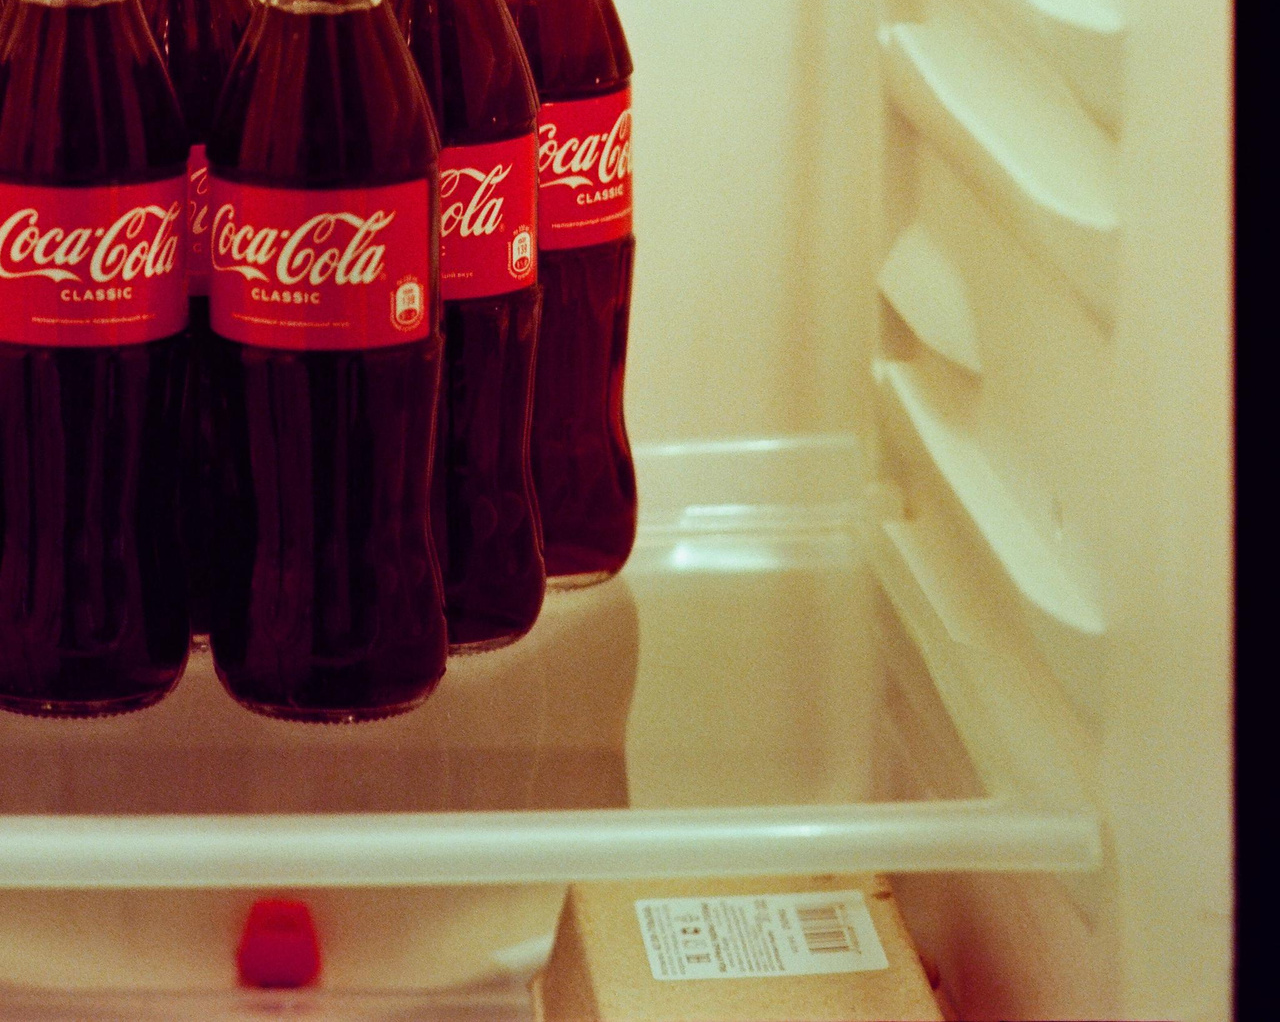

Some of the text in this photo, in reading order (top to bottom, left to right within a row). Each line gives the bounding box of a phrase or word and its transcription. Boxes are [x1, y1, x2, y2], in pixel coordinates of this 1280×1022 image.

[577, 184, 624, 206] CLASSIC
[211, 203, 396, 286] Coca-Cola
[60, 287, 132, 302] CLASSIC
[251, 287, 321, 304] CLASSIC
